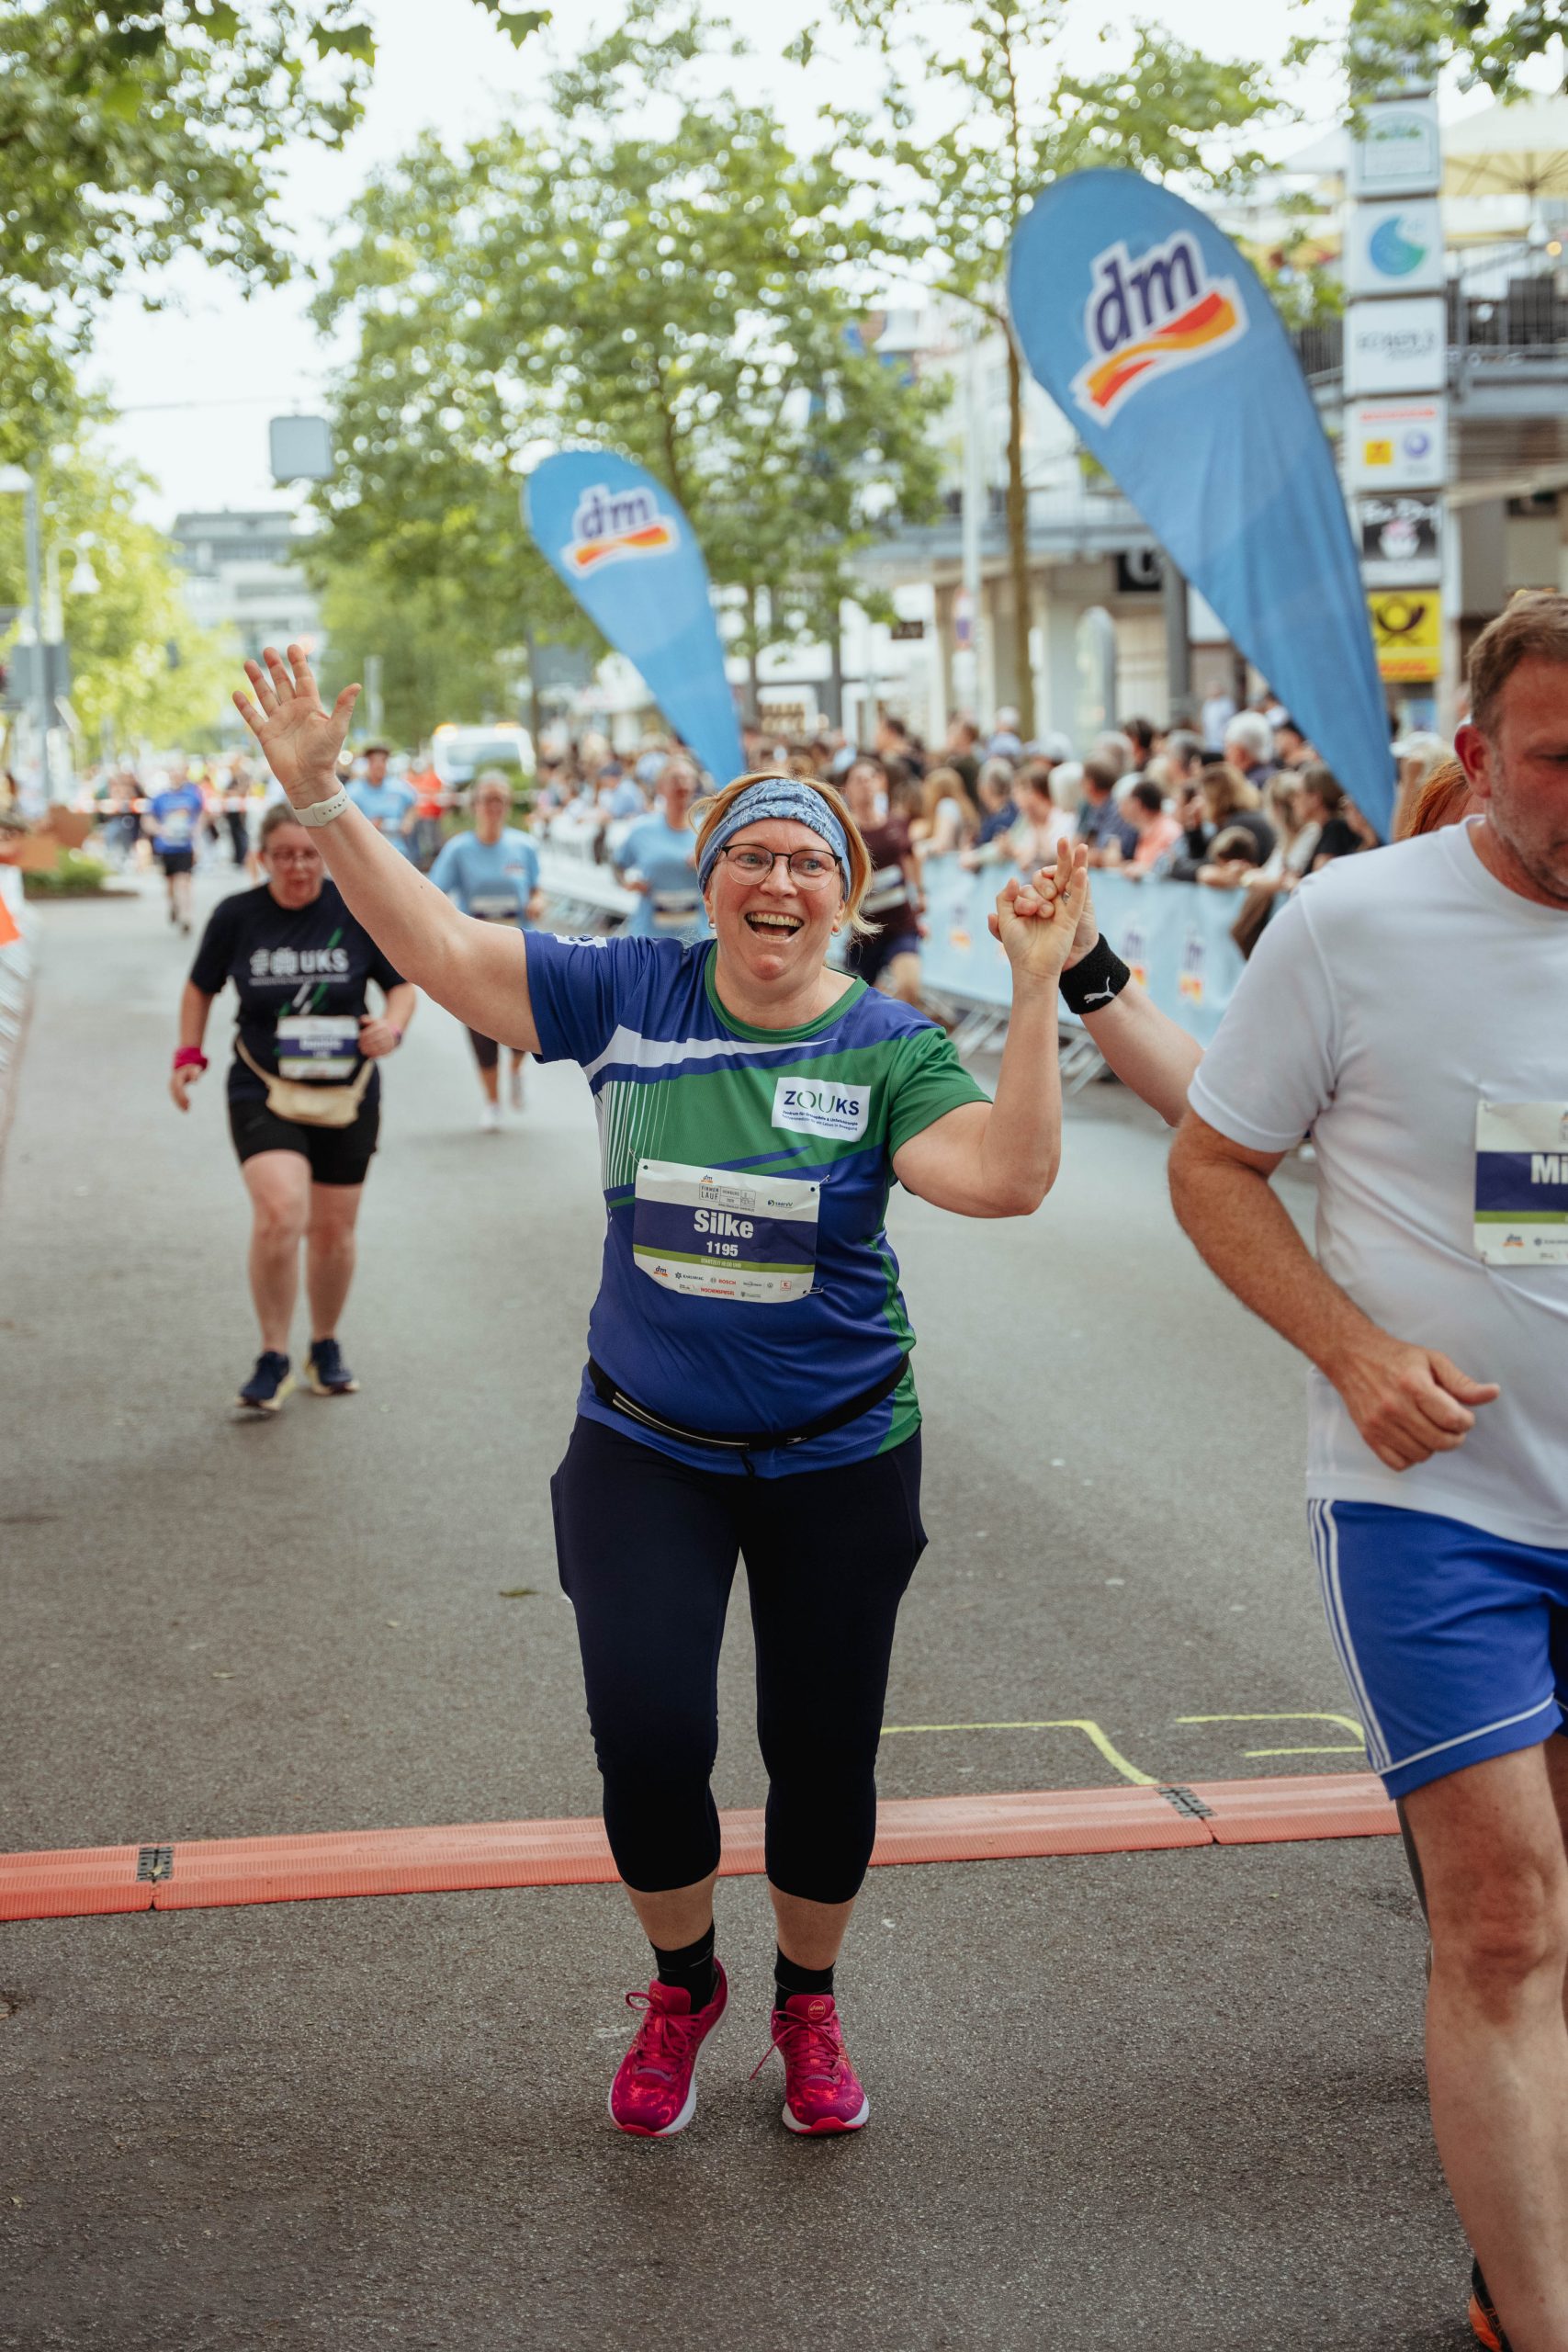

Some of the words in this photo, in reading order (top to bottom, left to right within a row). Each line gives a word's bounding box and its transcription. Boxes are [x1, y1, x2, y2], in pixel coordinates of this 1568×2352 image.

[1096, 241, 1198, 353] dm
[581, 494, 650, 539] dm
[784, 1091, 860, 1116] ZOUKS
[701, 1192, 718, 1200] LAUF
[694, 1209, 754, 1238] Silke
[706, 1240, 739, 1257] 1195
[655, 1265, 667, 1273] dm
